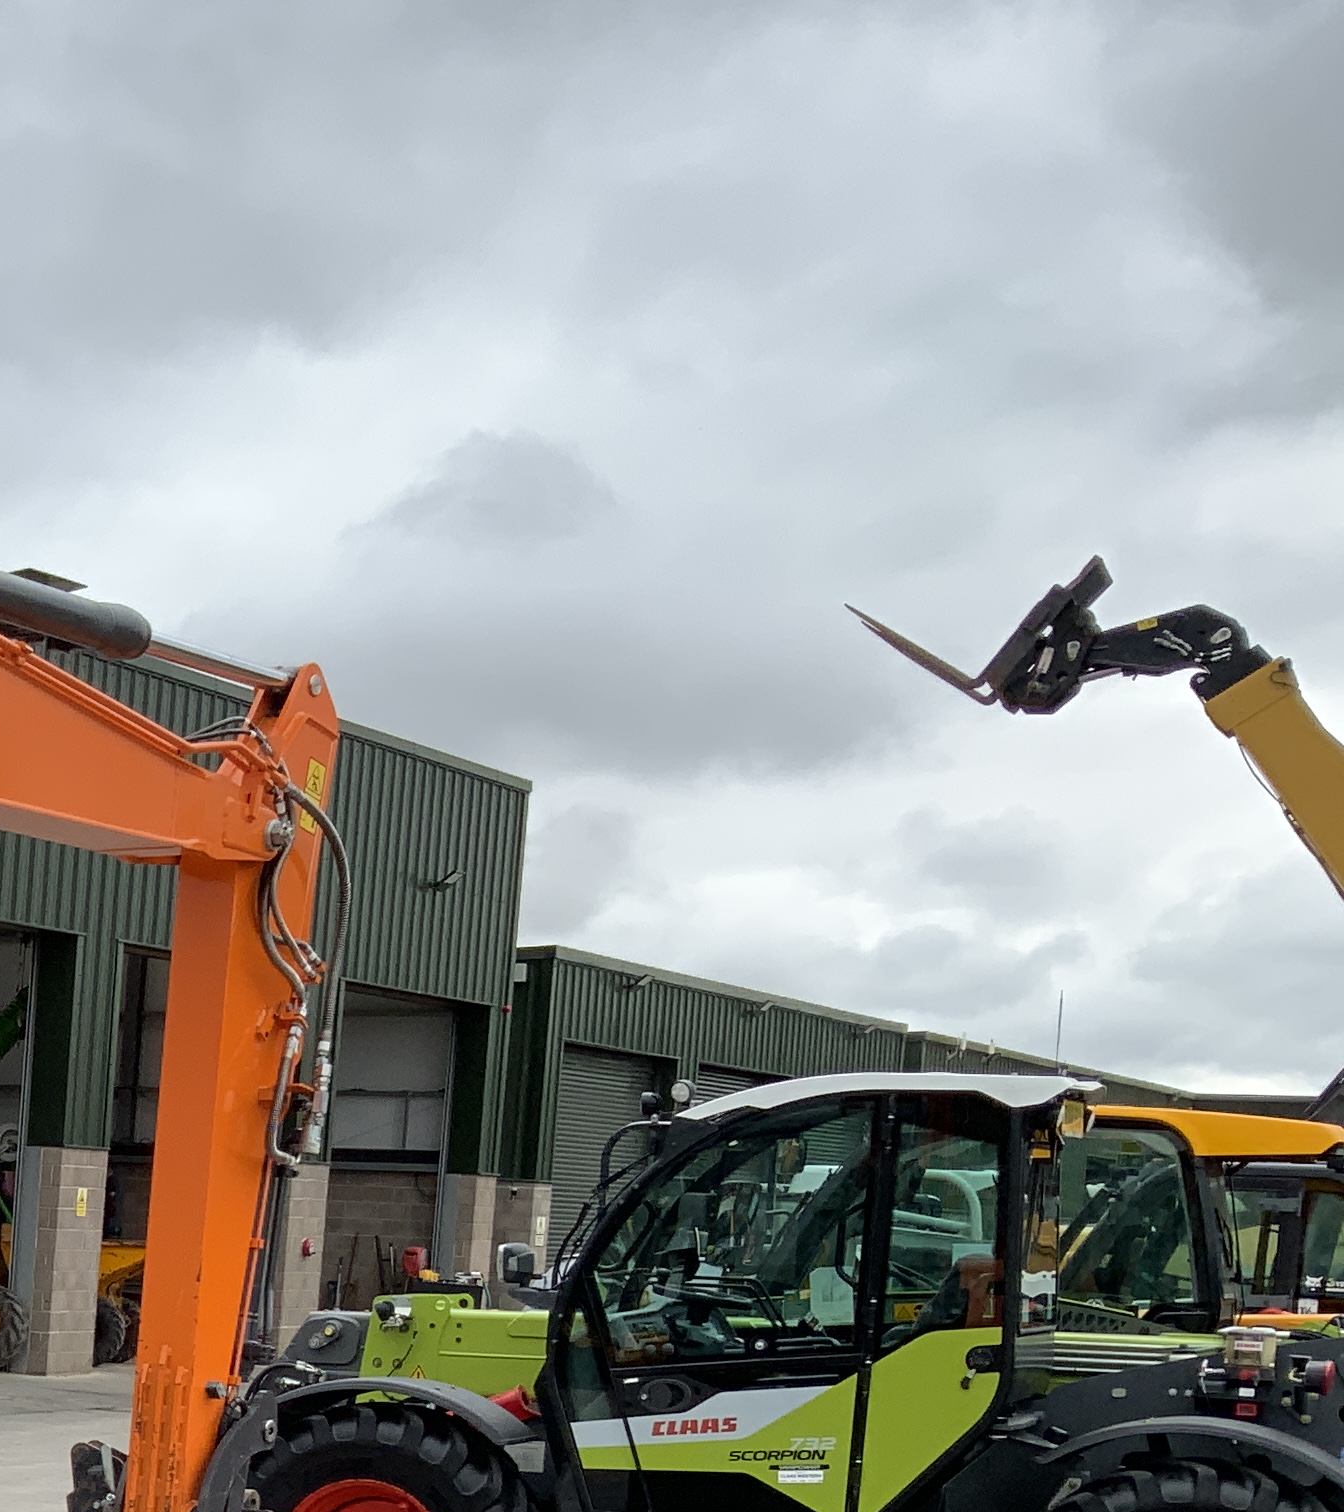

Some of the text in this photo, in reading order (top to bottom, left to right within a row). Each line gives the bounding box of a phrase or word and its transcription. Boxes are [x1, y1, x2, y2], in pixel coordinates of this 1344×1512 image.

[651, 1417, 737, 1436] CLAAS
[789, 1437, 837, 1450] 732
[729, 1450, 826, 1461] SCORPION
